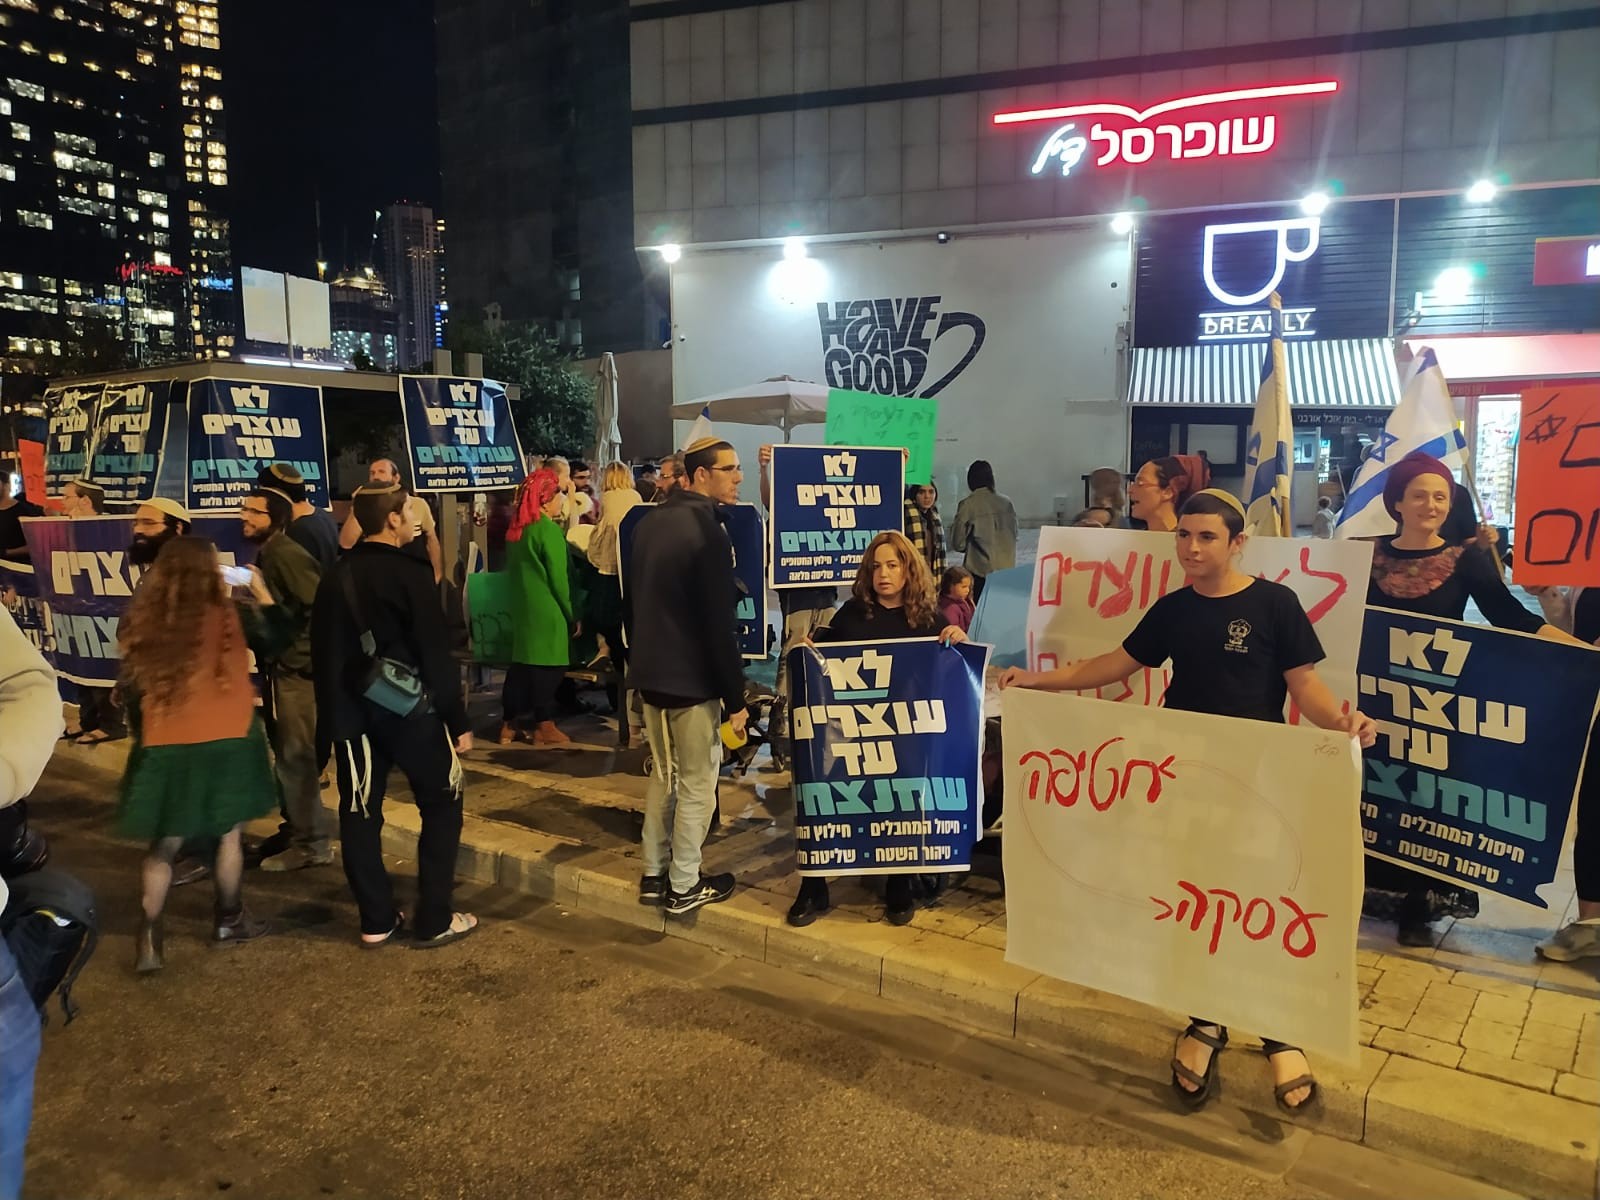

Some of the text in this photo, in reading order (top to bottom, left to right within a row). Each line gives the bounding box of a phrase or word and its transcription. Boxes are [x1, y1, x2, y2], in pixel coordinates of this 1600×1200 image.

[1089, 115, 1276, 167] שופרסל
[1203, 312, 1312, 335] BREALY
[824, 347, 929, 397] GOOD
[229, 384, 270, 409] לא
[448, 381, 478, 403] לא
[201, 413, 302, 438] עוצרים
[453, 427, 481, 445] עד
[235, 437, 276, 458] עד
[822, 451, 858, 477] לא
[796, 484, 882, 506] עוצרים
[823, 507, 857, 529] עד
[780, 530, 878, 552] תנצחים
[1389, 627, 1473, 677] לא
[825, 649, 894, 690] לא
[792, 699, 948, 741] עוצרים
[1360, 673, 1527, 744] עוצרי
[830, 740, 898, 776] עד
[1374, 718, 1449, 771] עד
[1019, 737, 1164, 812] חטיפה
[796, 776, 968, 817] שתנצח
[1364, 757, 1548, 843] שתנצ
[812, 822, 852, 842] חילוץ
[870, 818, 932, 837] המחבלים
[934, 818, 961, 835] חיסול
[1399, 812, 1474, 847] המחבלים
[810, 848, 857, 865] שליטה
[875, 846, 919, 863] השטח
[922, 845, 952, 861] טיהור
[1398, 839, 1450, 868] השטח
[1477, 833, 1525, 864] חיסול
[1453, 856, 1500, 884] טיהור
[1175, 880, 1329, 958] עסקה
